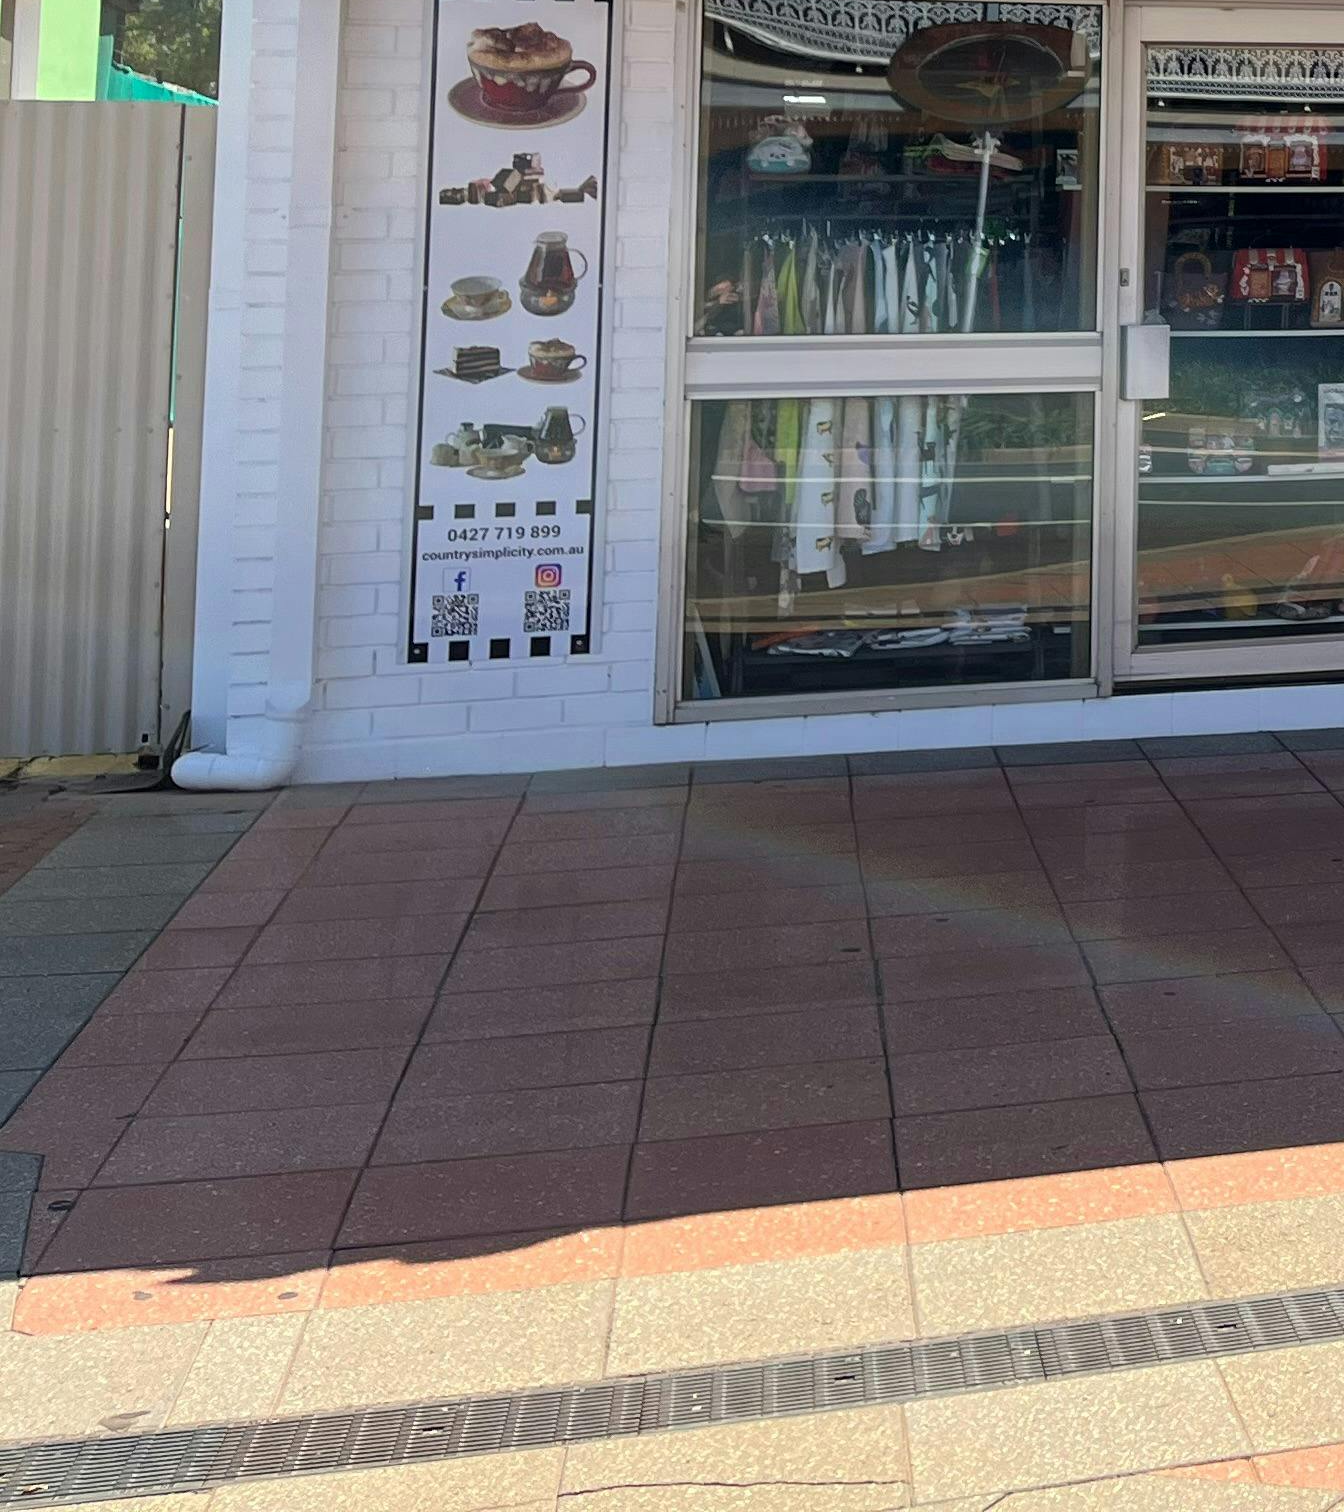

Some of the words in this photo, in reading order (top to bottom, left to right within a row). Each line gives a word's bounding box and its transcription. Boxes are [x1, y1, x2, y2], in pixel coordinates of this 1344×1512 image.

[447, 527, 490, 542] 0427
[495, 526, 526, 540] 719
[530, 525, 561, 539] 899
[422, 545, 585, 562] countrysimplicity.com.au
